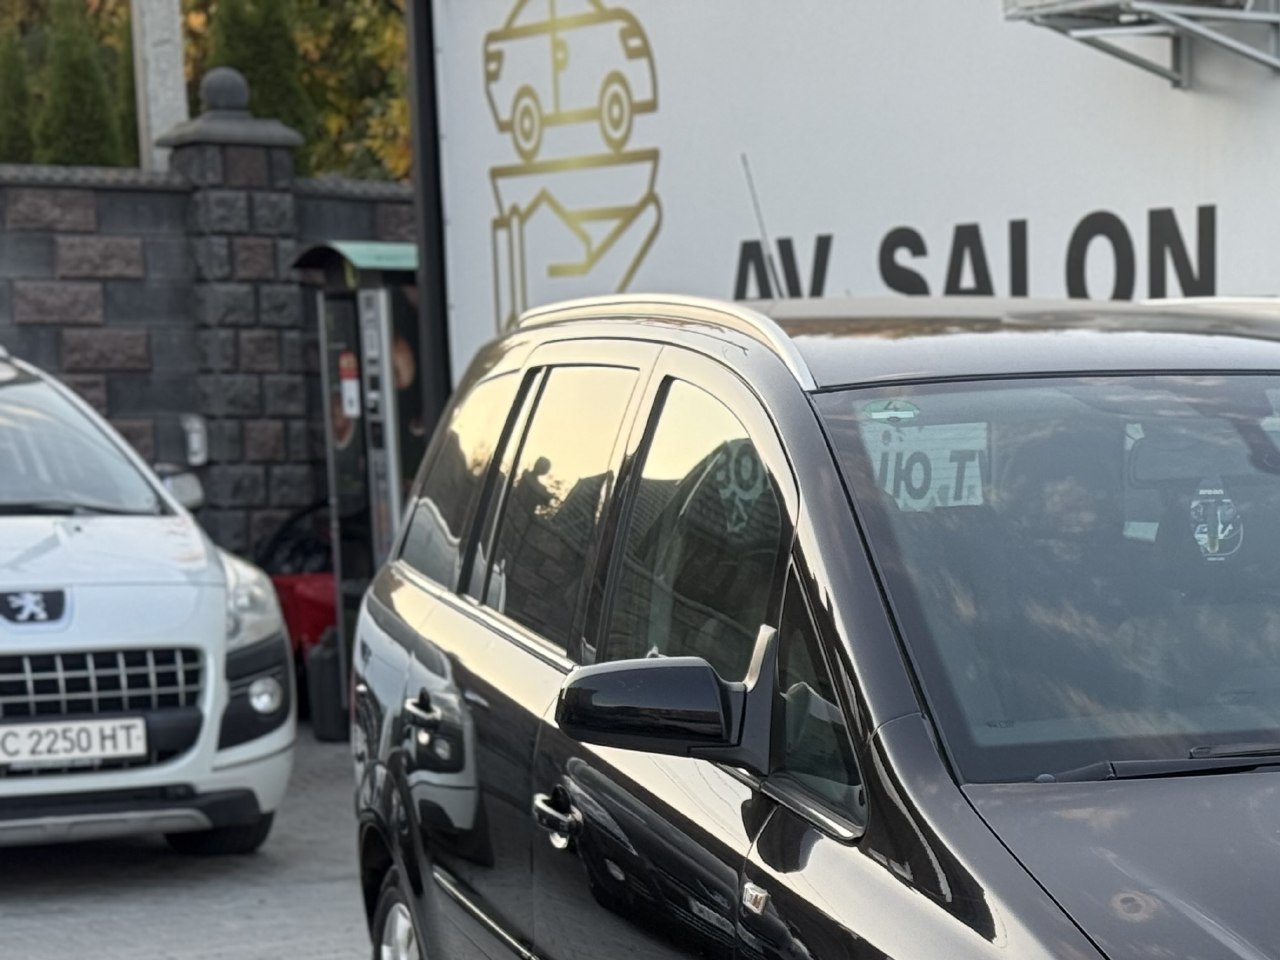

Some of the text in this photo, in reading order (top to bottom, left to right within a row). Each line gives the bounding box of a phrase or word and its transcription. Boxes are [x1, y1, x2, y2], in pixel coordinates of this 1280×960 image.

[877, 204, 1217, 301] SALON
[28, 727, 93, 756] 2250
[99, 723, 138, 752] HT
